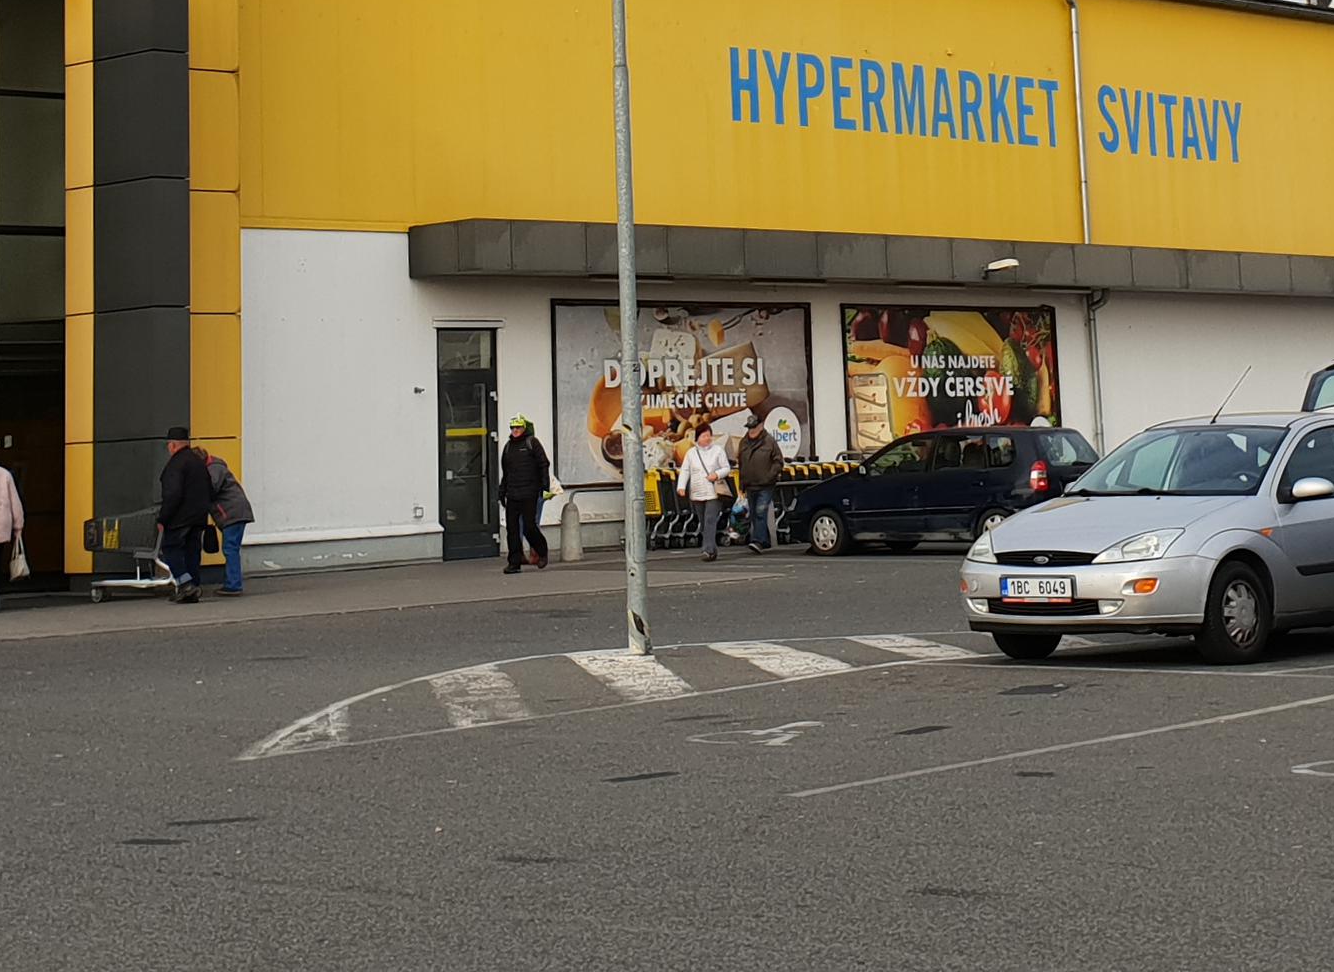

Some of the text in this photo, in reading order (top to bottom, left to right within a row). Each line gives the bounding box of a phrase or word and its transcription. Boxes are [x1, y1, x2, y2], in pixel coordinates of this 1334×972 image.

[728, 46, 1242, 163] HYPERMARKET SVITAVY
[910, 352, 996, 369] U NÁS NAJDETE
[741, 357, 764, 386] SI
[893, 370, 1015, 398] VŽDY ČERSTVÉ
[705, 388, 747, 408] CHUTĚ
[772, 429, 797, 442] lbert
[1010, 580, 1066, 595] 1BC 6049
